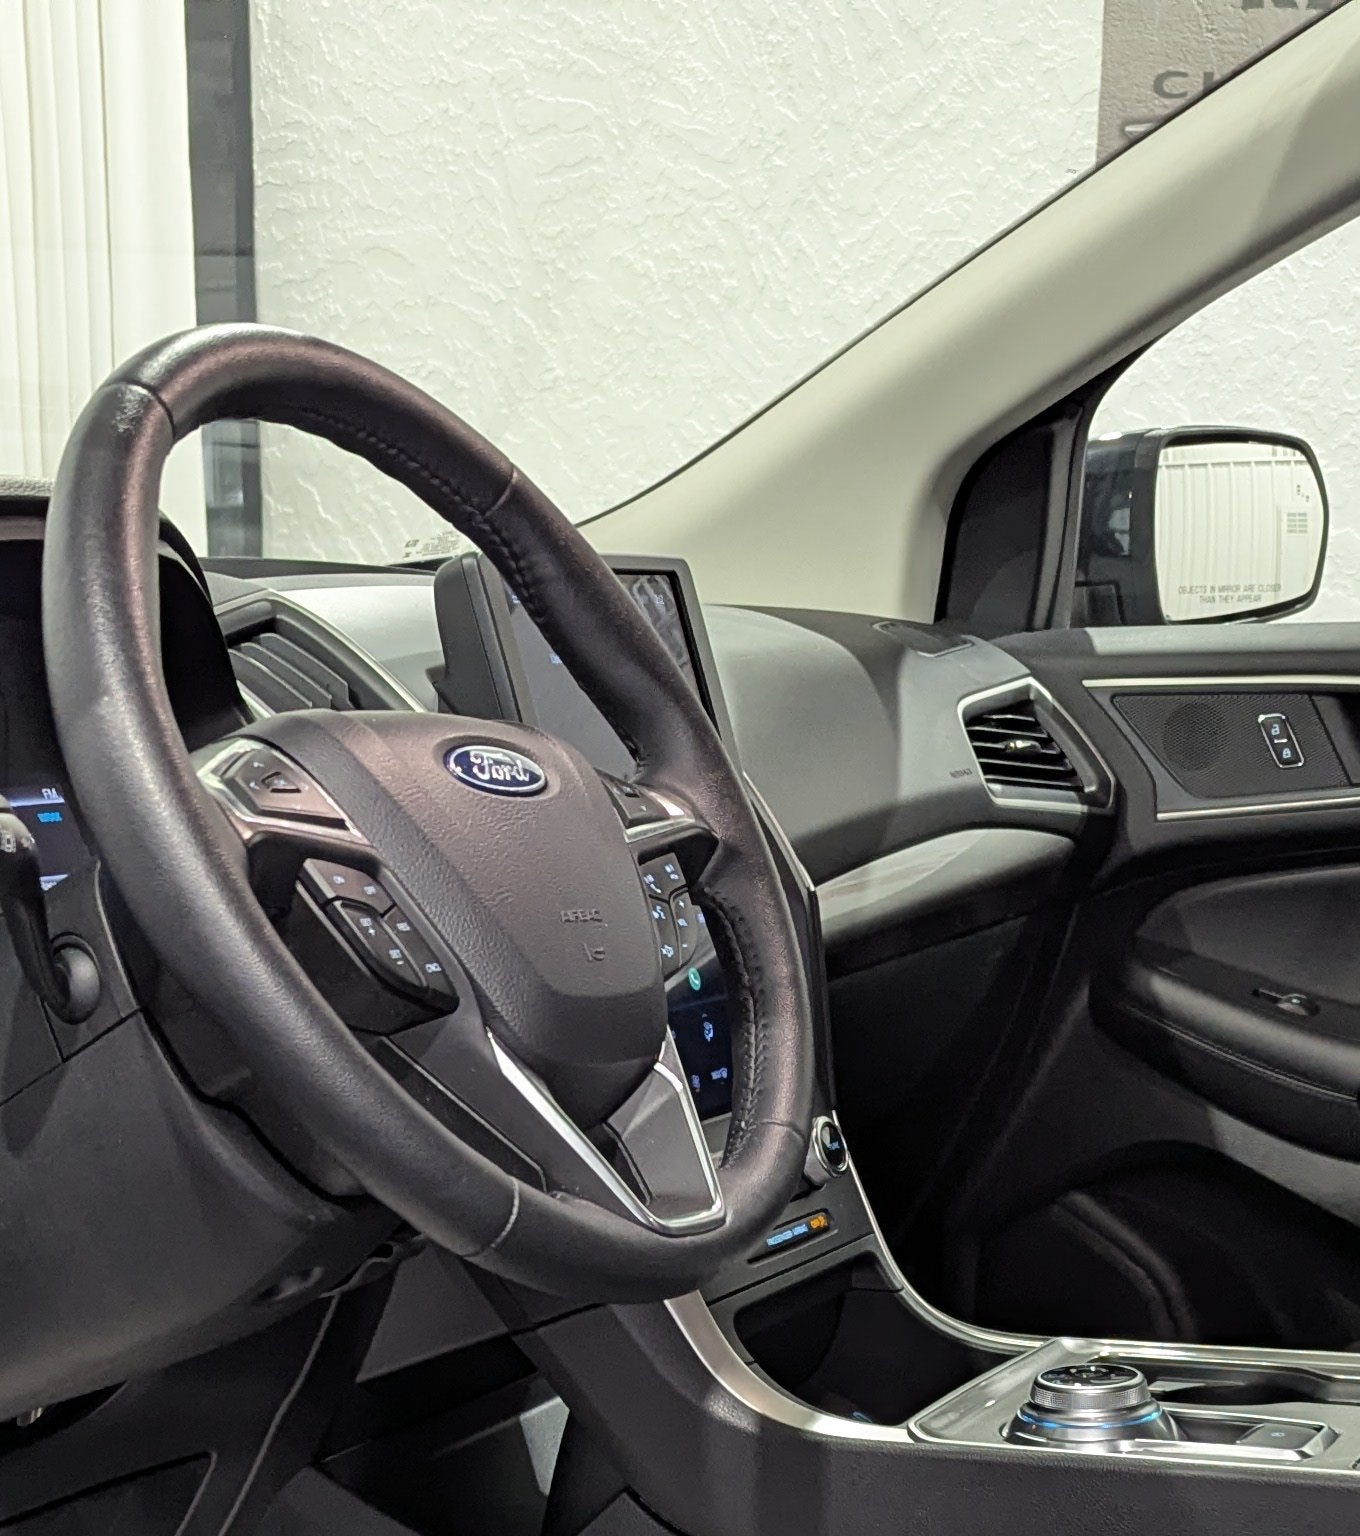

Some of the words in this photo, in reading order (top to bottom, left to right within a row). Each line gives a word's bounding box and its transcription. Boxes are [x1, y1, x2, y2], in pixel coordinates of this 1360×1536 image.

[1178, 585, 1207, 594] OBJECTS
[1210, 585, 1216, 593] IN
[1243, 584, 1255, 593] ARE
[1219, 594, 1234, 603] THEY
